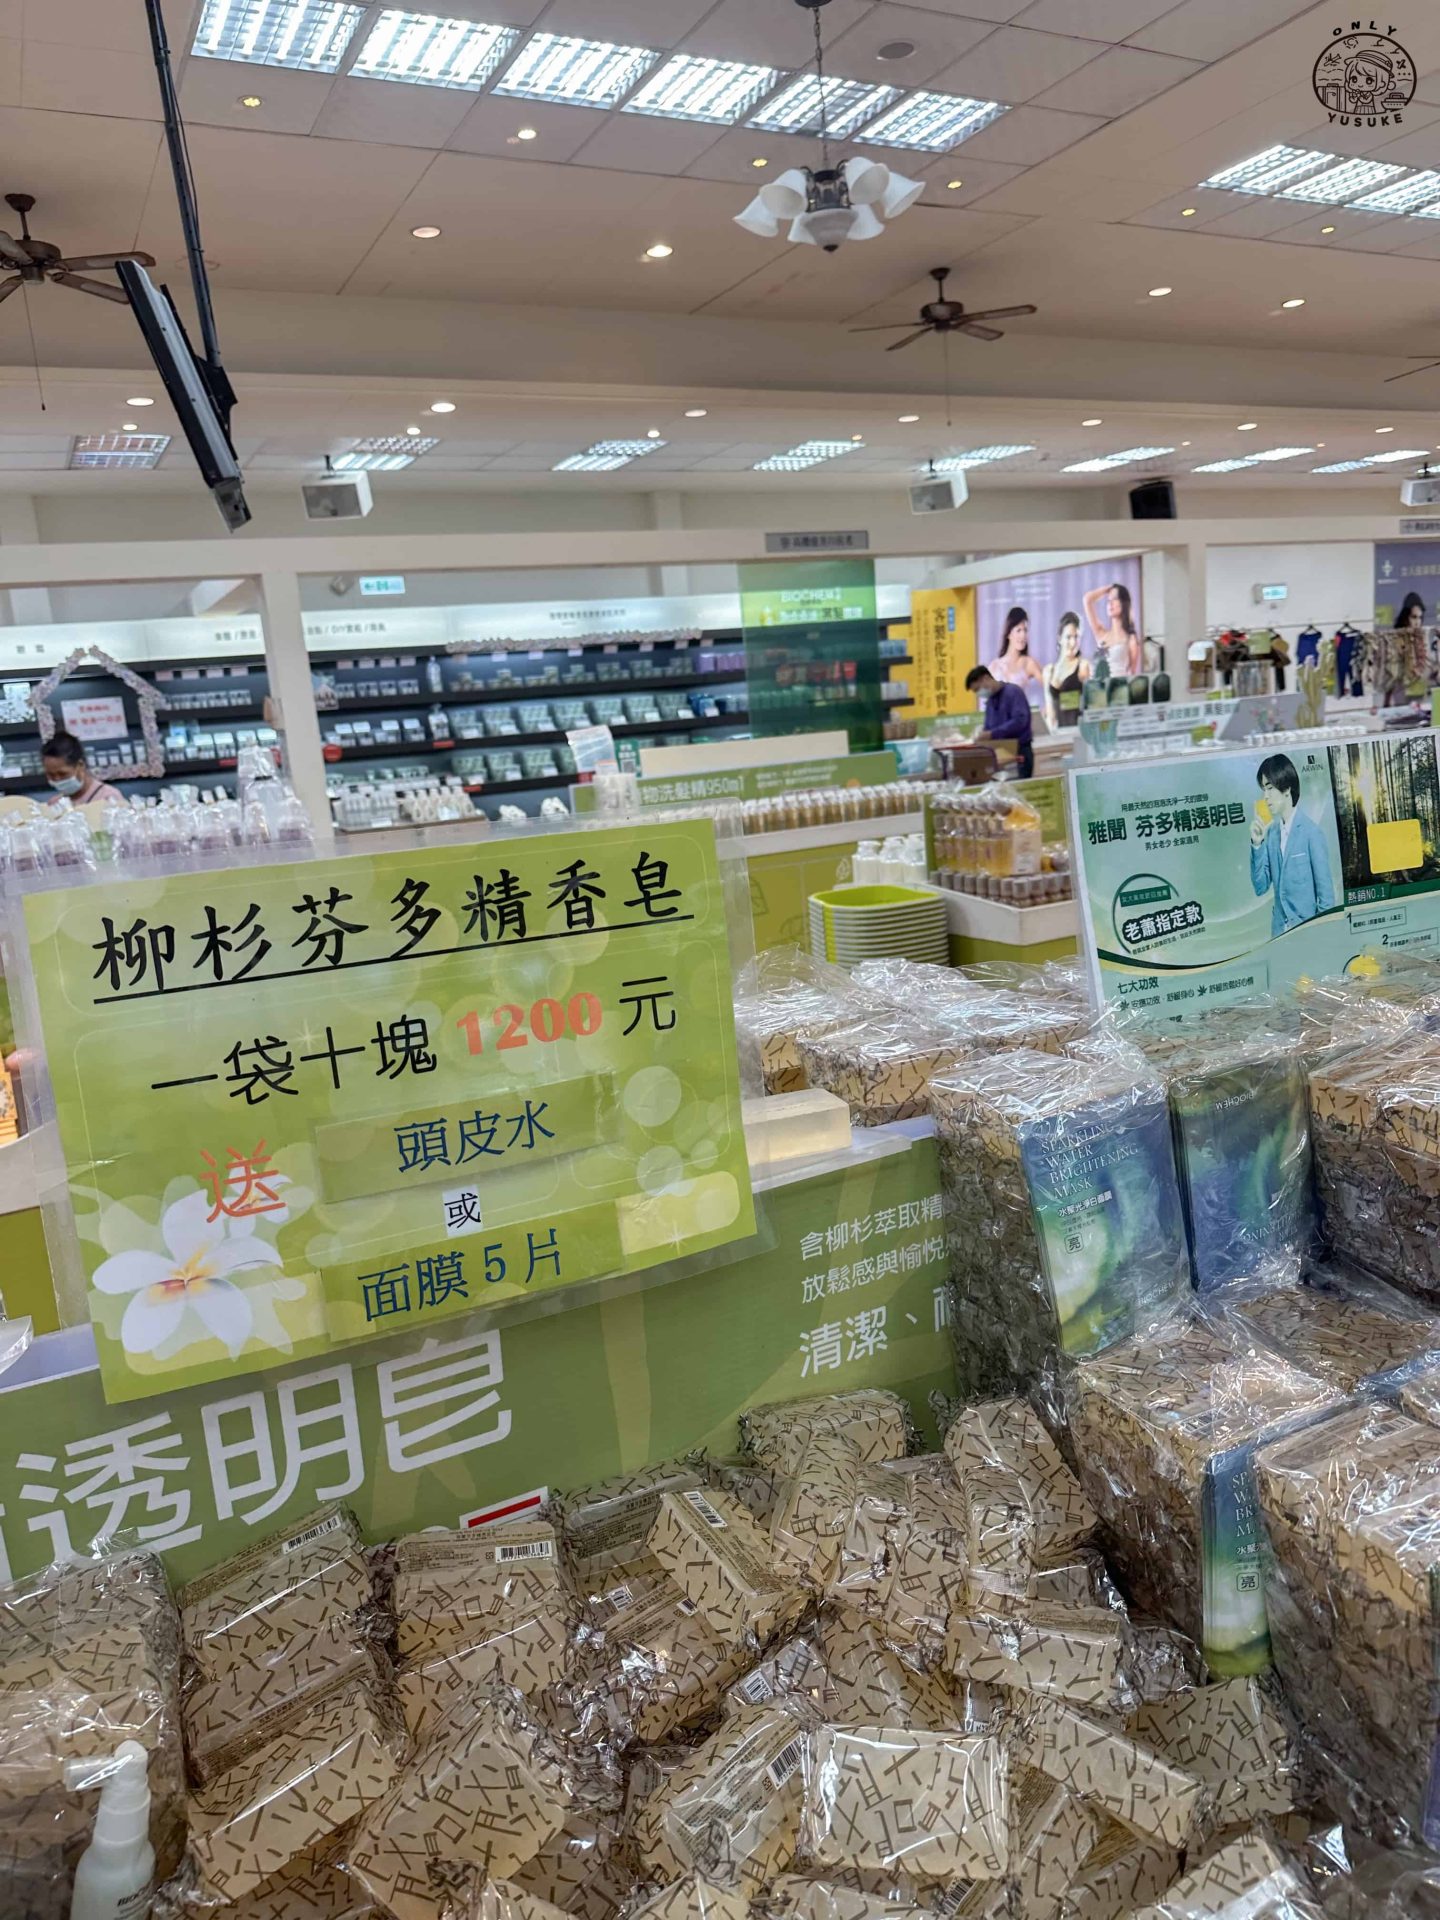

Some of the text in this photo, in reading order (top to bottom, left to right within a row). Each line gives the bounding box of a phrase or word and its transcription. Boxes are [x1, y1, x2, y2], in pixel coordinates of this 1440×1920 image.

[1302, 764, 1324, 773] ARWIN
[1088, 802, 1246, 845] 雅聞 芬多精透明皂
[93, 851, 683, 990] 柳杉芬多精香皂
[1125, 904, 1201, 941] 老蕭指定款
[1117, 976, 1159, 995] 七大功效
[151, 976, 676, 1105] 一袋十塊 1200 元
[395, 1099, 556, 1174] 頭皮水
[1041, 1120, 1114, 1155] SPARKLING
[1044, 1144, 1094, 1169] WATER
[1049, 1143, 1139, 1184] BRIGHTENING
[200, 1138, 286, 1224] 送
[1053, 1177, 1094, 1200] MASK
[445, 1193, 481, 1230] 或
[1068, 1237, 1081, 1251] 亮
[358, 1229, 562, 1324] 面膜 5 片
[801, 1235, 952, 1304] 放鬆感與愉悅
[0, 1329, 512, 1586] 透明皂
[1241, 1576, 1256, 1590] 亮
